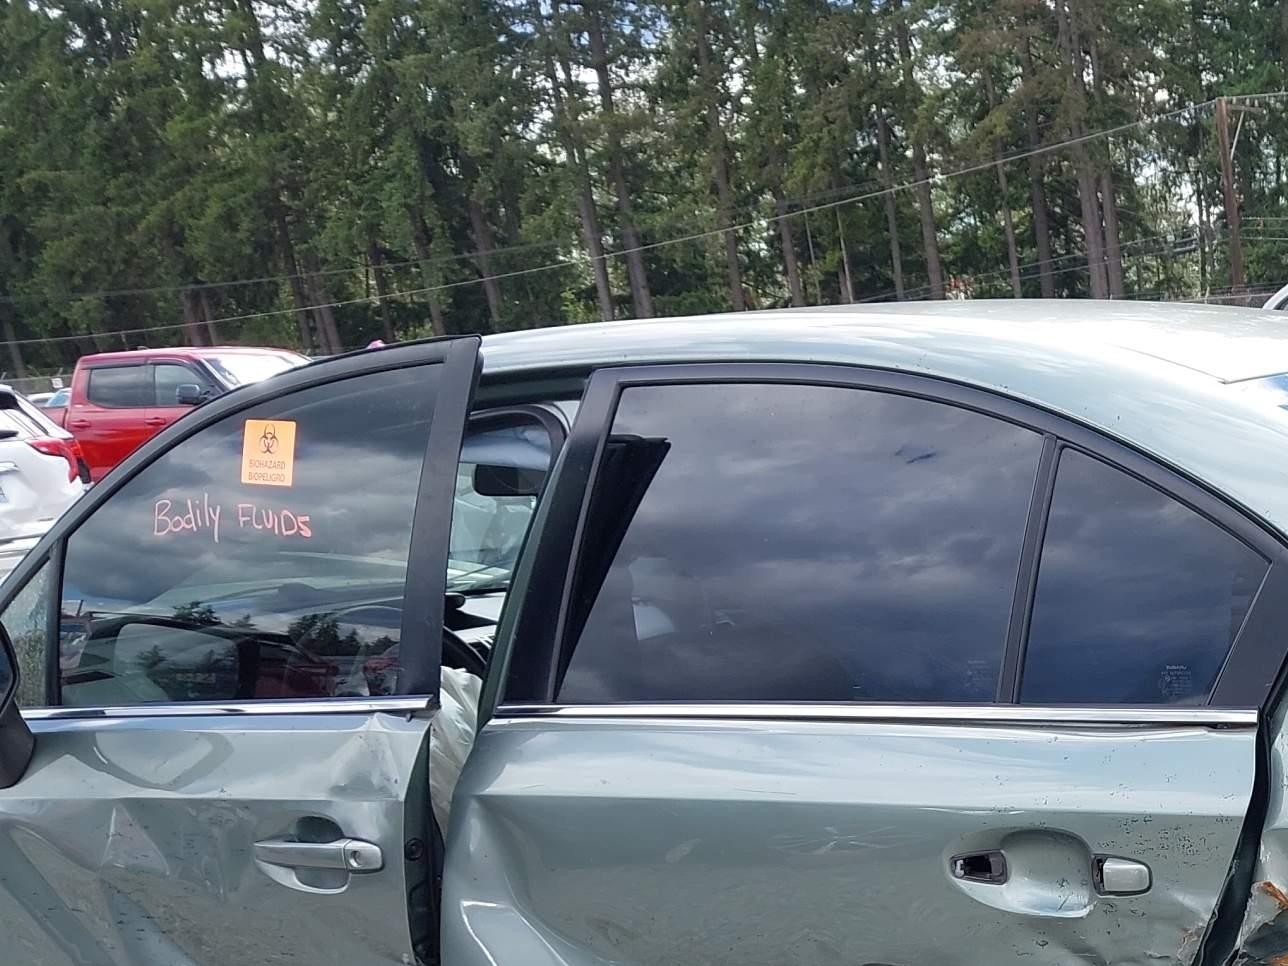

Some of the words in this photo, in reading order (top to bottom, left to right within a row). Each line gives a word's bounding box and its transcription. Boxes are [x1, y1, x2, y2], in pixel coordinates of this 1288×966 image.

[249, 459, 286, 470] BIOHAZARD
[248, 472, 286, 482] BIOPELIGRO
[154, 493, 221, 543] Bodily
[238, 503, 312, 538] FLUIDS
